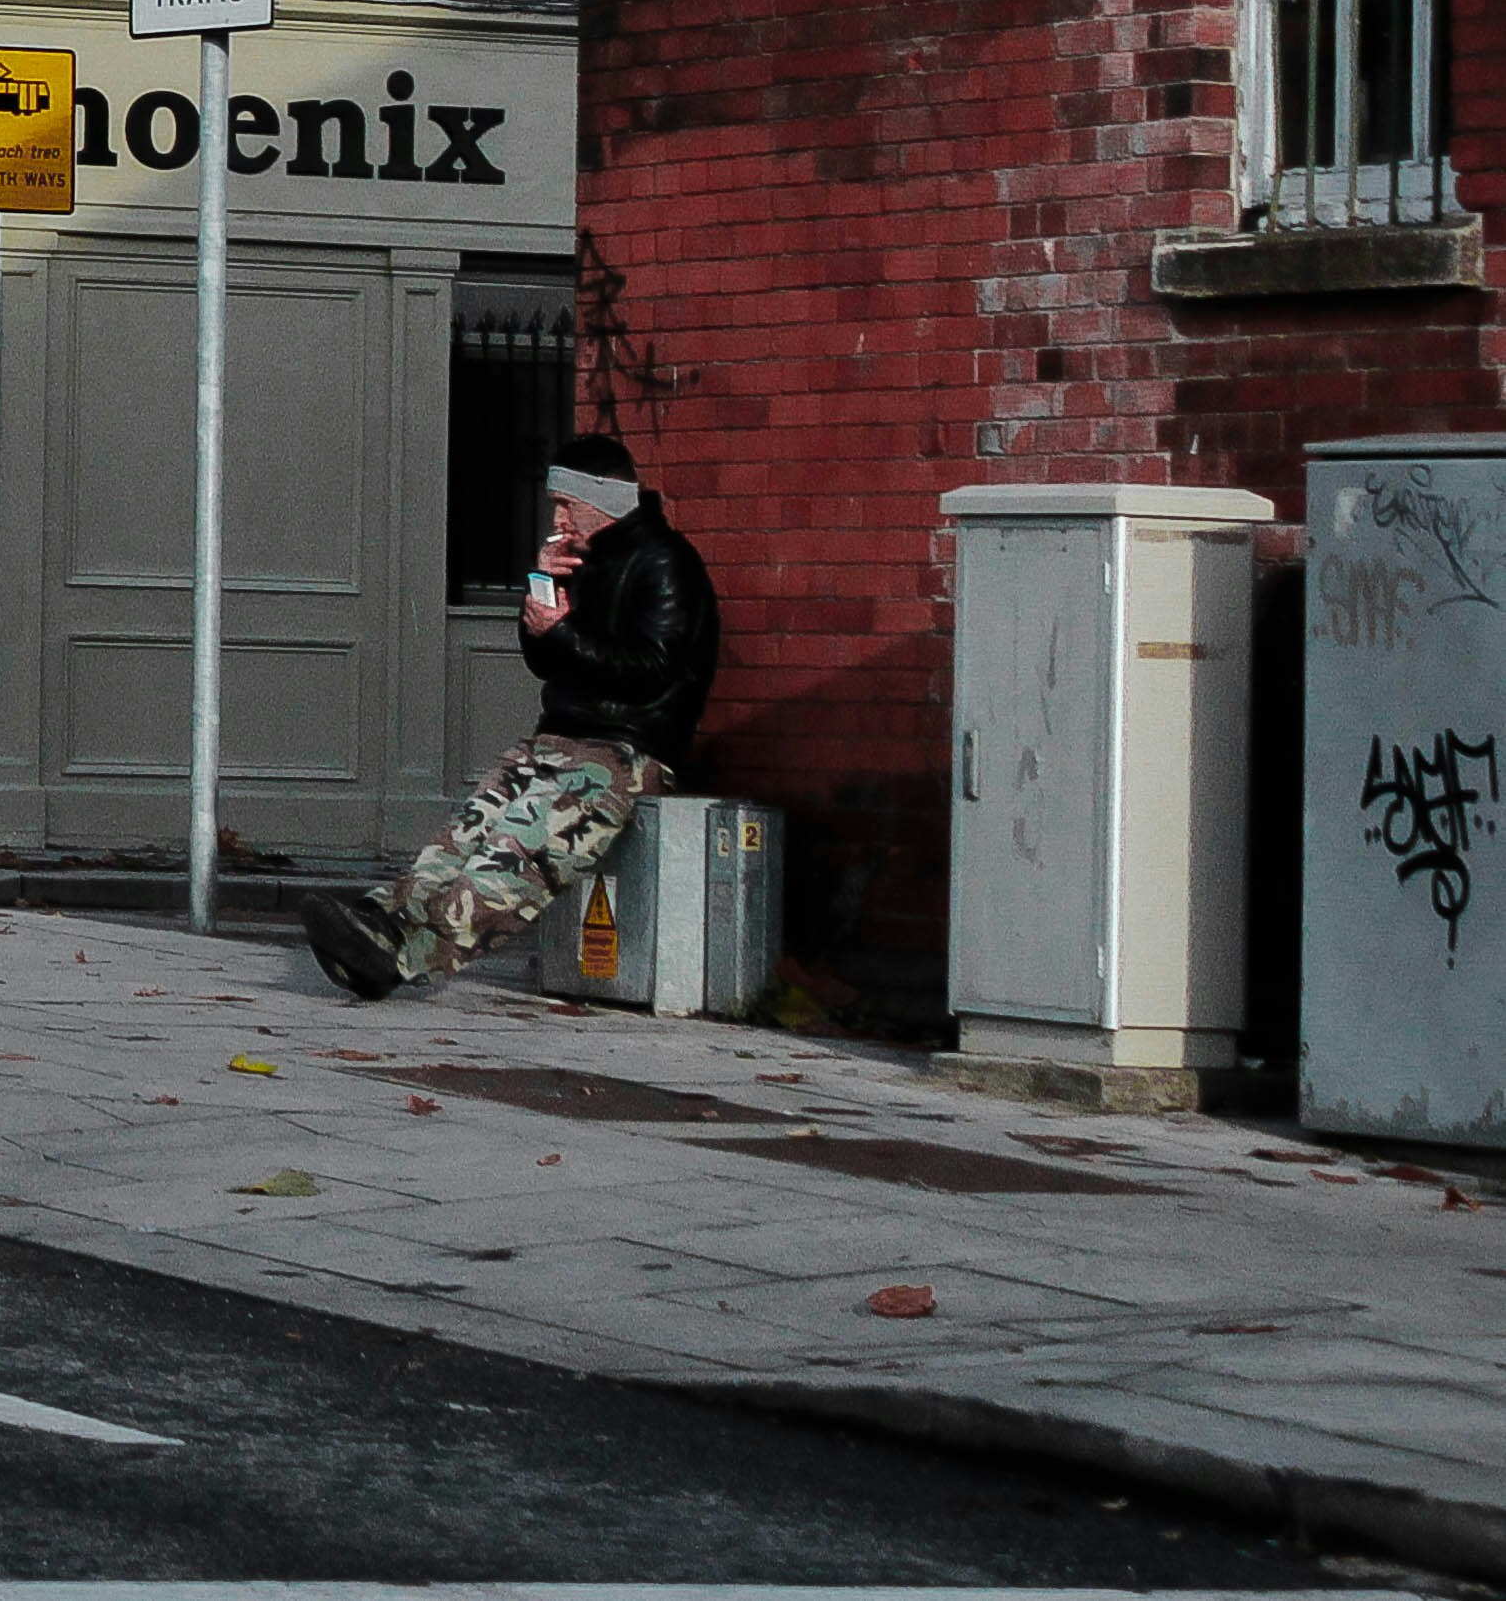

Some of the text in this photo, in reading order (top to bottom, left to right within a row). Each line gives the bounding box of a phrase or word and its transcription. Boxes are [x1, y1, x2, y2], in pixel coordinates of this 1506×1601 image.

[30, 144, 61, 160] treo
[23, 171, 66, 188] WAYS
[745, 825, 758, 847] 2
